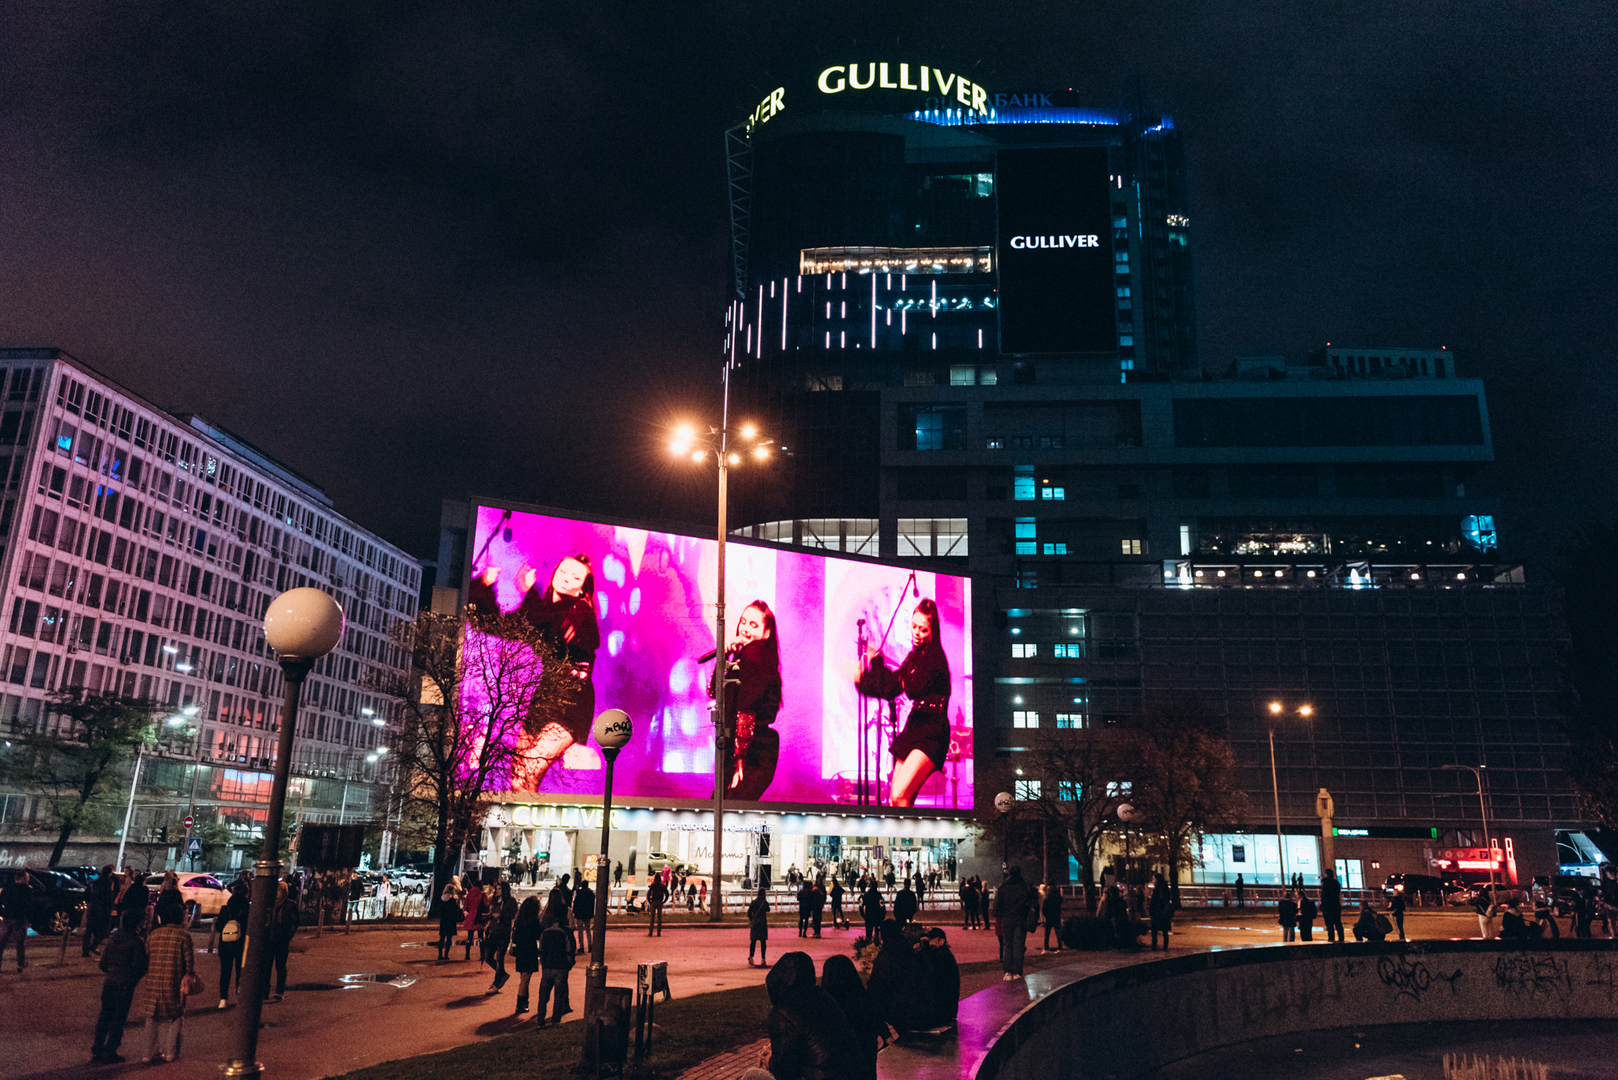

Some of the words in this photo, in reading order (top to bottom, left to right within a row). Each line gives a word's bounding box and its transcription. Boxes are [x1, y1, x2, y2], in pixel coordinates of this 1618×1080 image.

[817, 61, 989, 112] GULLIVER
[1010, 234, 1100, 250] GULLIVER
[512, 806, 620, 829] GULLIVER
[694, 846, 744, 859] Maimo
